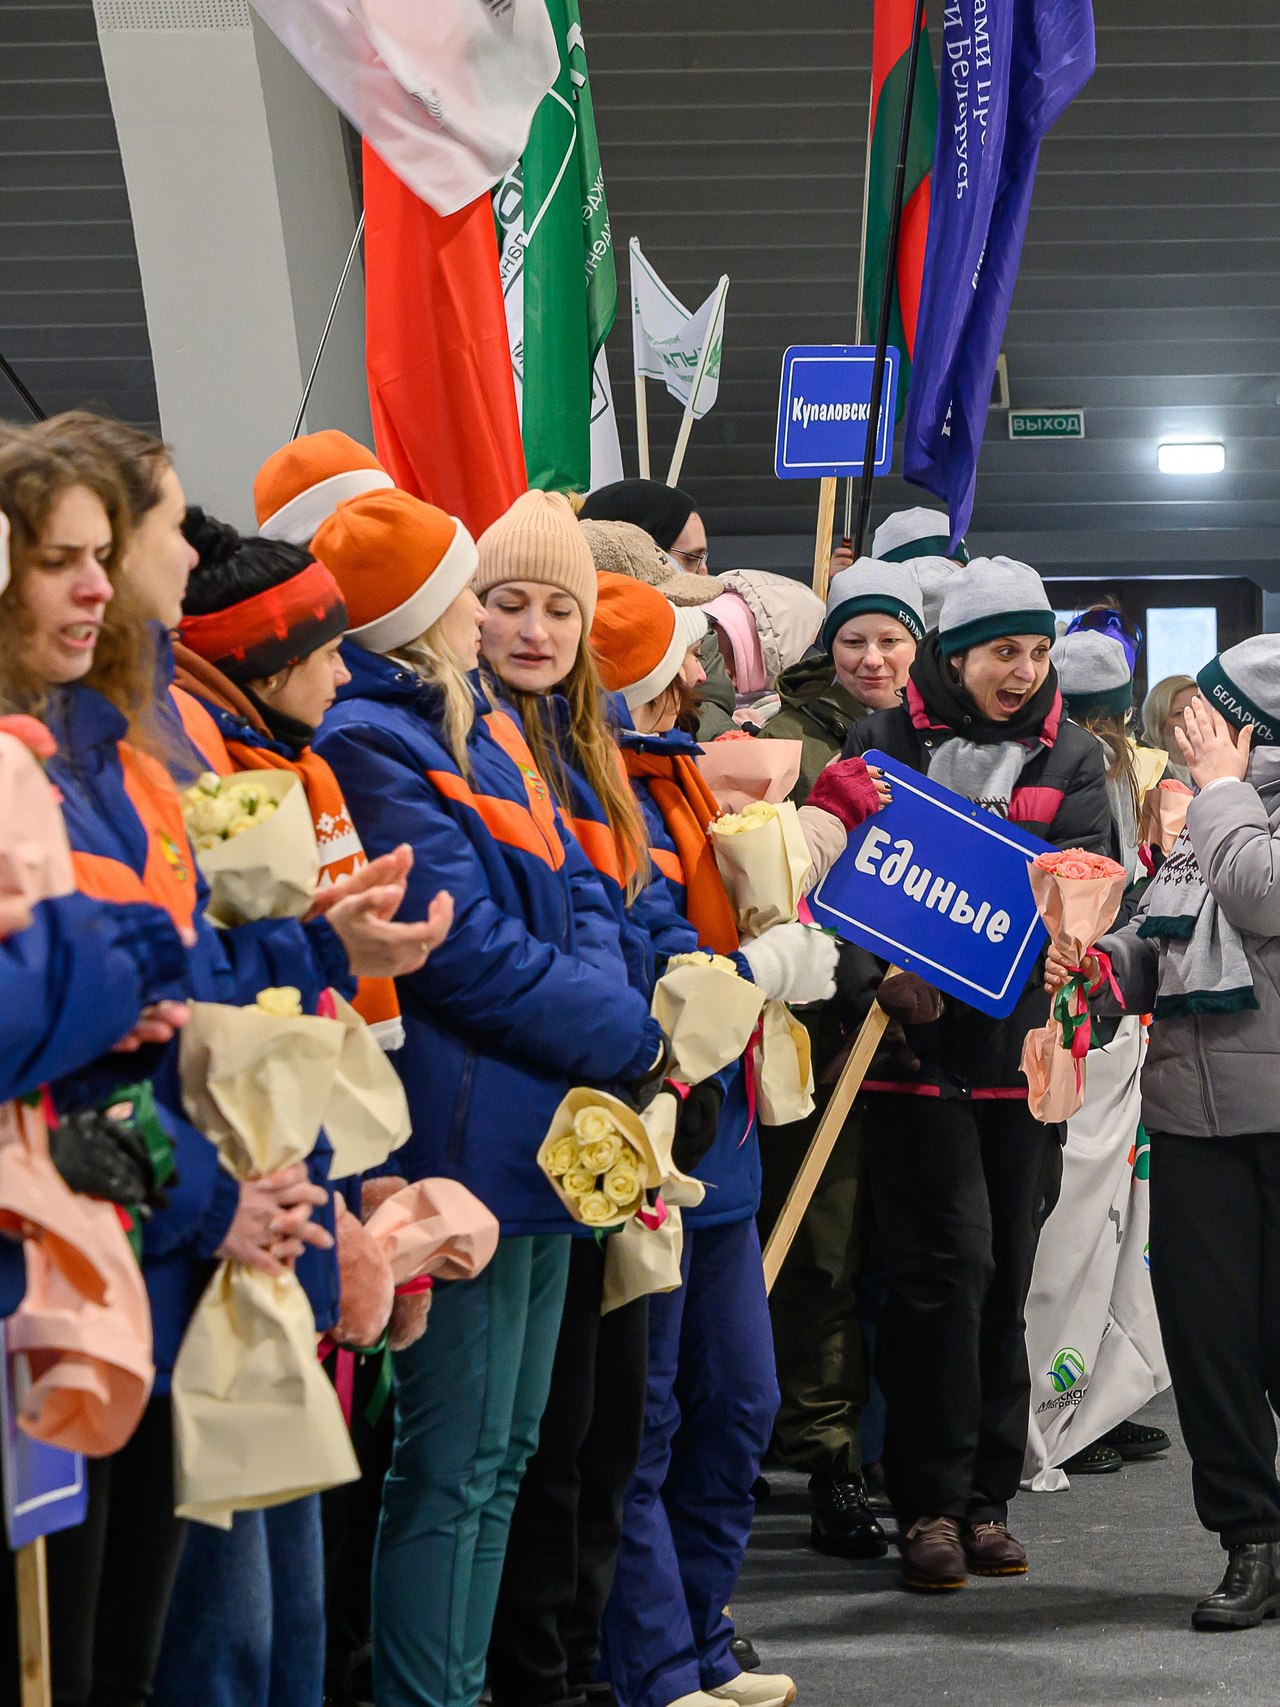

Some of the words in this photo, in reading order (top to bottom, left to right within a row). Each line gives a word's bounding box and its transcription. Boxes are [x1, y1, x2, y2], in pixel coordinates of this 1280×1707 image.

[946, 36, 972, 200] Беларусь
[792, 396, 883, 429] Купаловск
[1013, 417, 1080, 432] ВЫХОД
[1212, 684, 1274, 741] БЕЛАРУСЬ
[854, 825, 1011, 943] Единые
